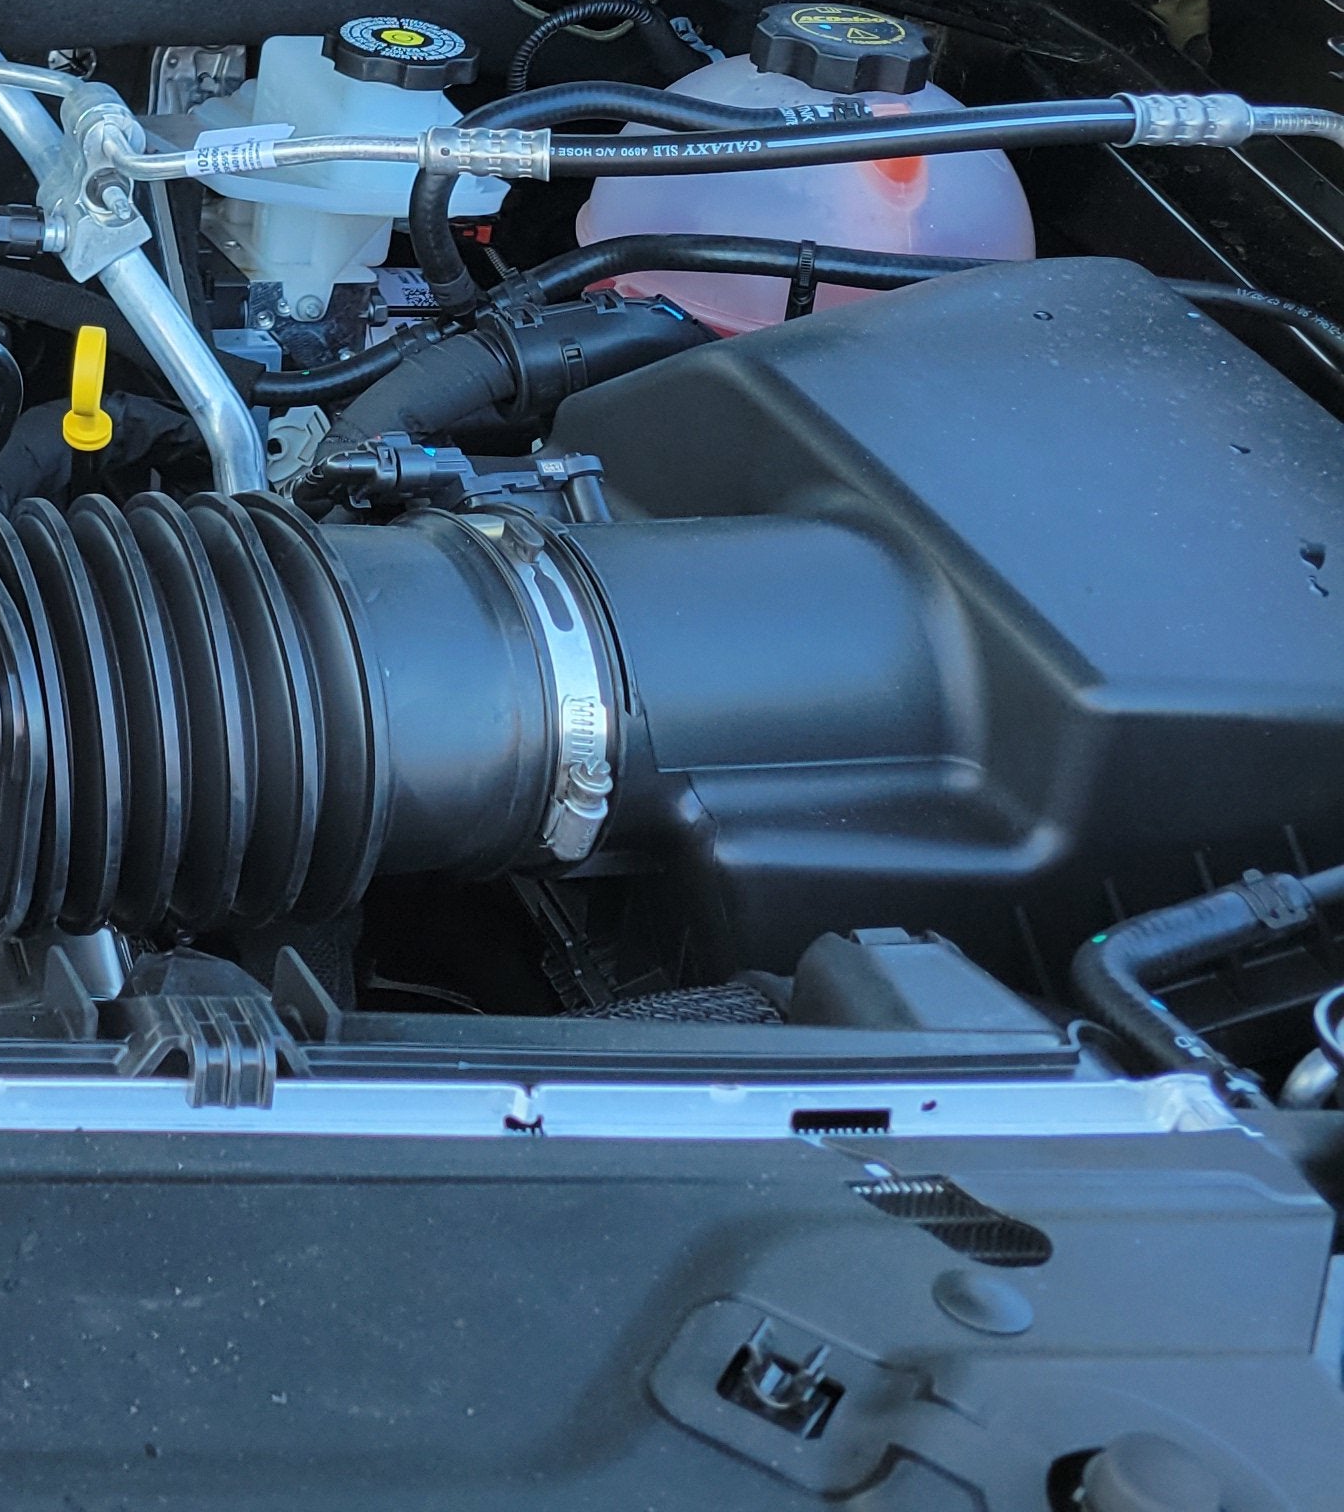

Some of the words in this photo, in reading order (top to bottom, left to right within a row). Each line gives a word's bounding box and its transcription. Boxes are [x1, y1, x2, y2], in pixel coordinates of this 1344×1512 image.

[558, 148, 593, 157] HOSE
[595, 148, 614, 157] A/C
[653, 144, 678, 157] SLE
[682, 140, 761, 157] GALAXY
